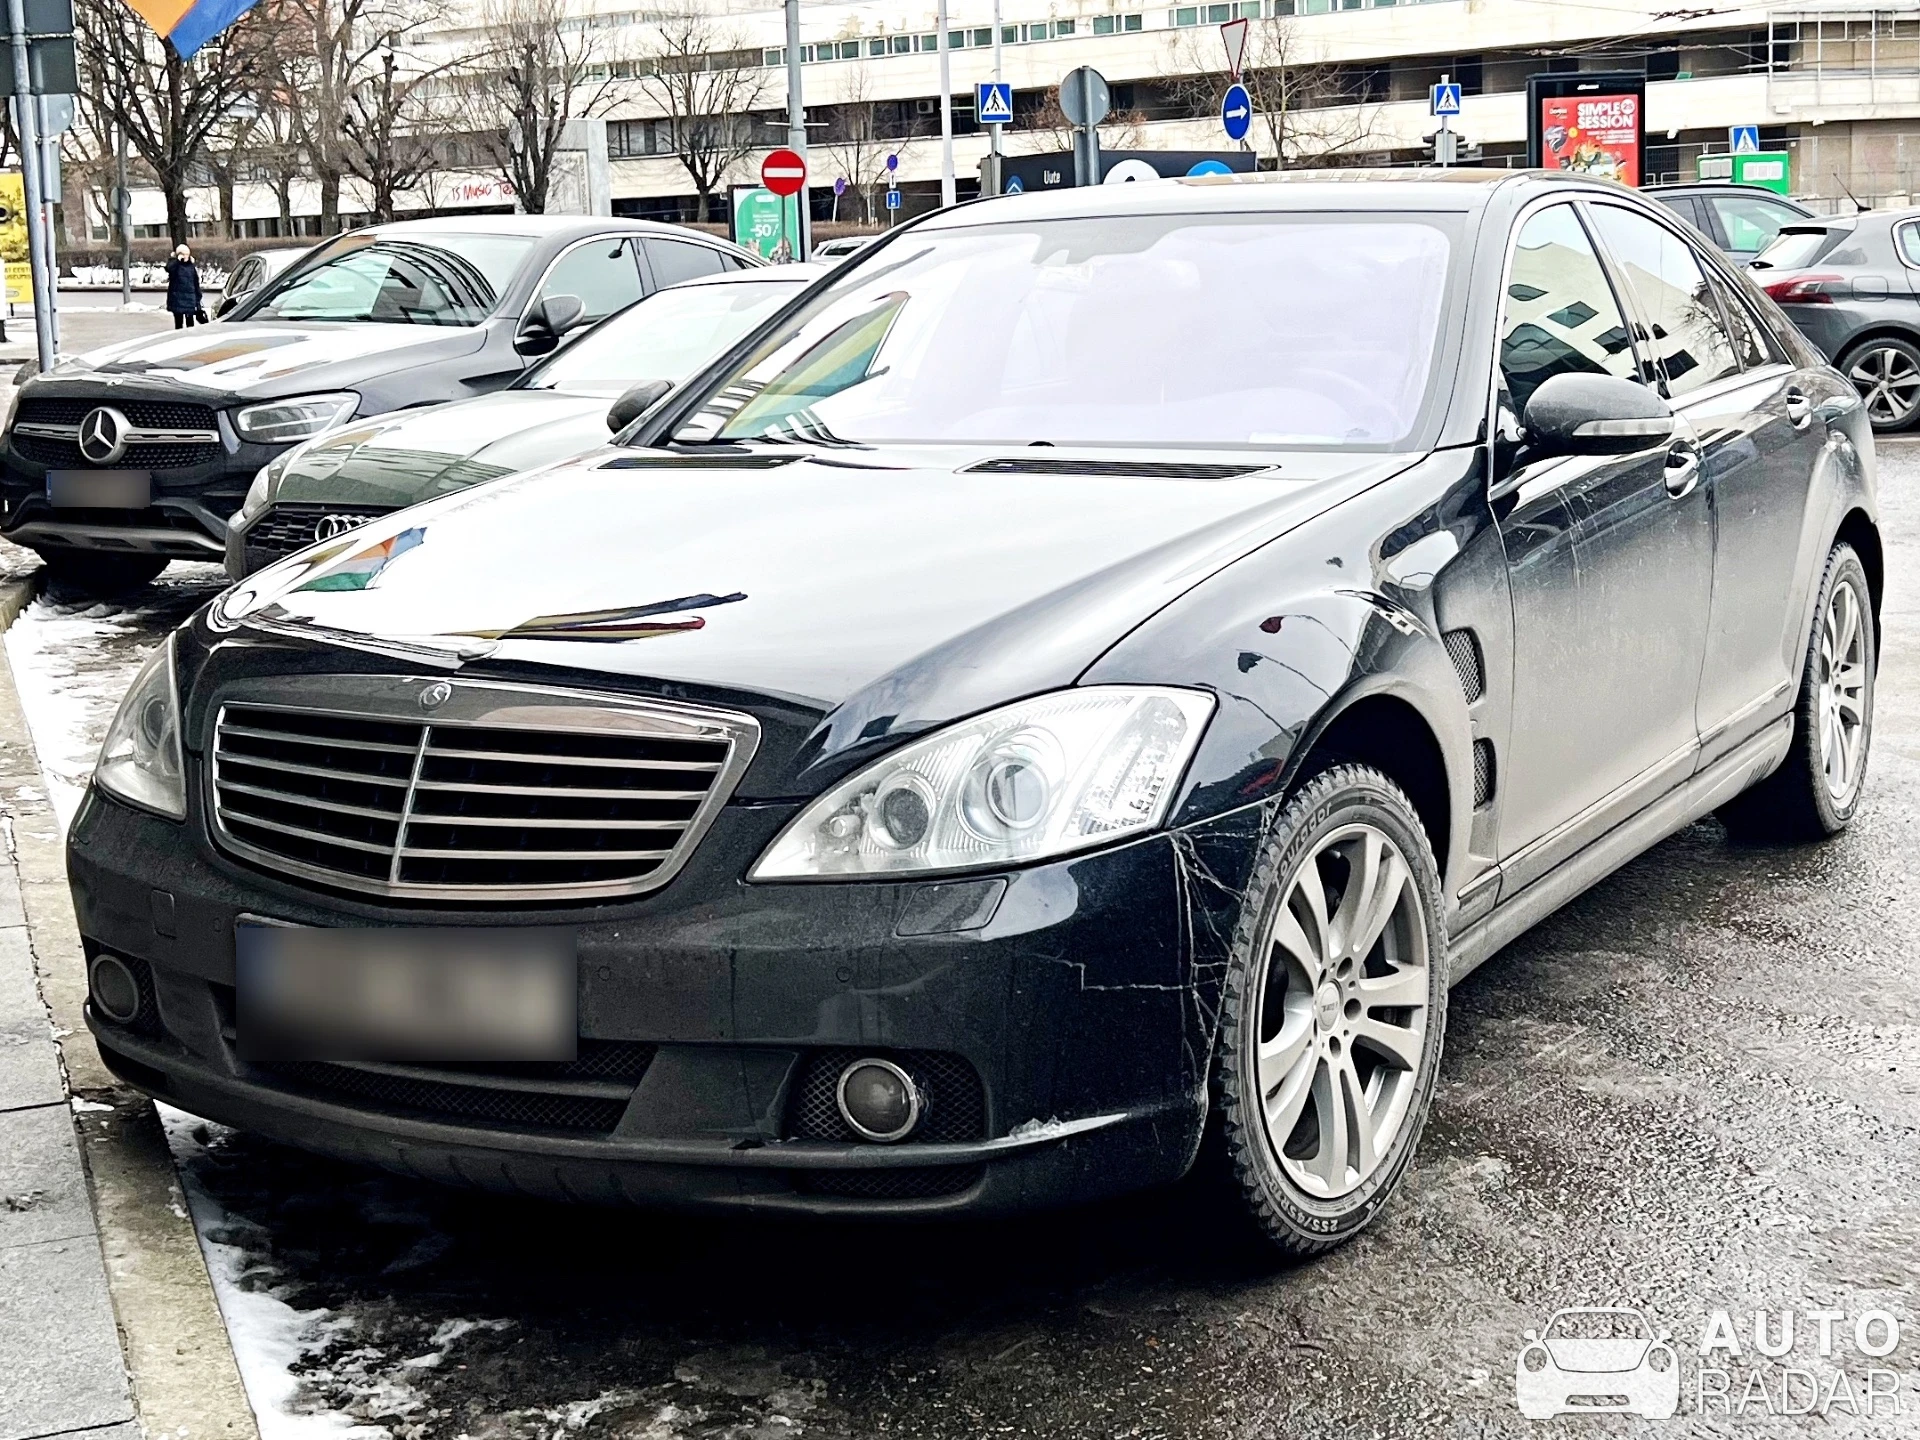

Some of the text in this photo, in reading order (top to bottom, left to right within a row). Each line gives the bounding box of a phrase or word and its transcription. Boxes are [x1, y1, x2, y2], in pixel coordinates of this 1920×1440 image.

[1577, 101, 1621, 117] SIMPLE
[1577, 114, 1634, 130] SESSION
[1272, 801, 1333, 889] Tourador
